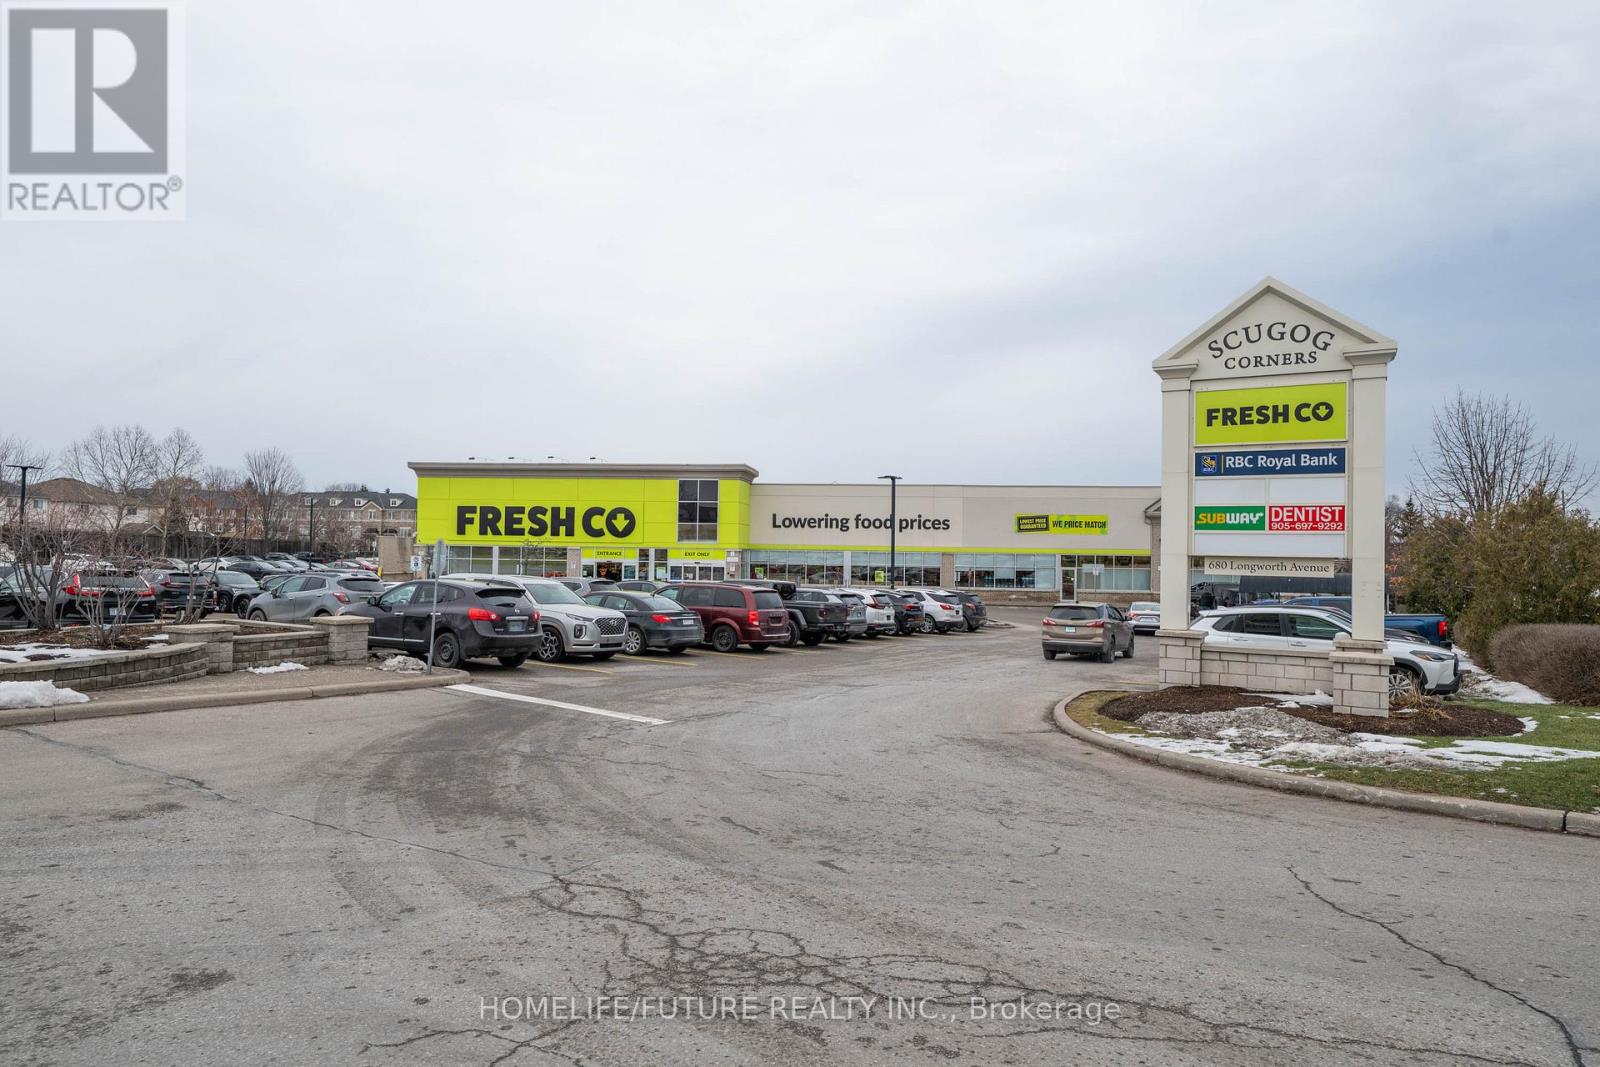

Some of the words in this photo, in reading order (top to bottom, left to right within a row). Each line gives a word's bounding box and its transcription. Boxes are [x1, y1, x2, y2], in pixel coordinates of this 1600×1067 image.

[1207, 322, 1335, 359] SCUGOG
[1224, 351, 1317, 370] CORNERS
[1206, 404, 1290, 428] FRESH
[1294, 401, 1334, 423] CO
[1225, 455, 1253, 469] RBC
[1257, 454, 1297, 470] Royal
[1300, 452, 1338, 466] Bank
[456, 505, 576, 537] FRESH
[581, 506, 637, 539] CO
[772, 512, 850, 533] Lowering
[898, 514, 950, 533] prices
[1196, 512, 1265, 524] SUBWAY
[1271, 506, 1344, 522] DENTIST
[1052, 520, 1062, 528] WE
[1064, 520, 1083, 528] PRICE
[1084, 521, 1107, 529] MATCH
[1271, 522, 1344, 530] 905-697-9292
[1208, 560, 1228, 571] 680
[1230, 560, 1287, 575] Longworth
[1289, 561, 1331, 573] Avenue
